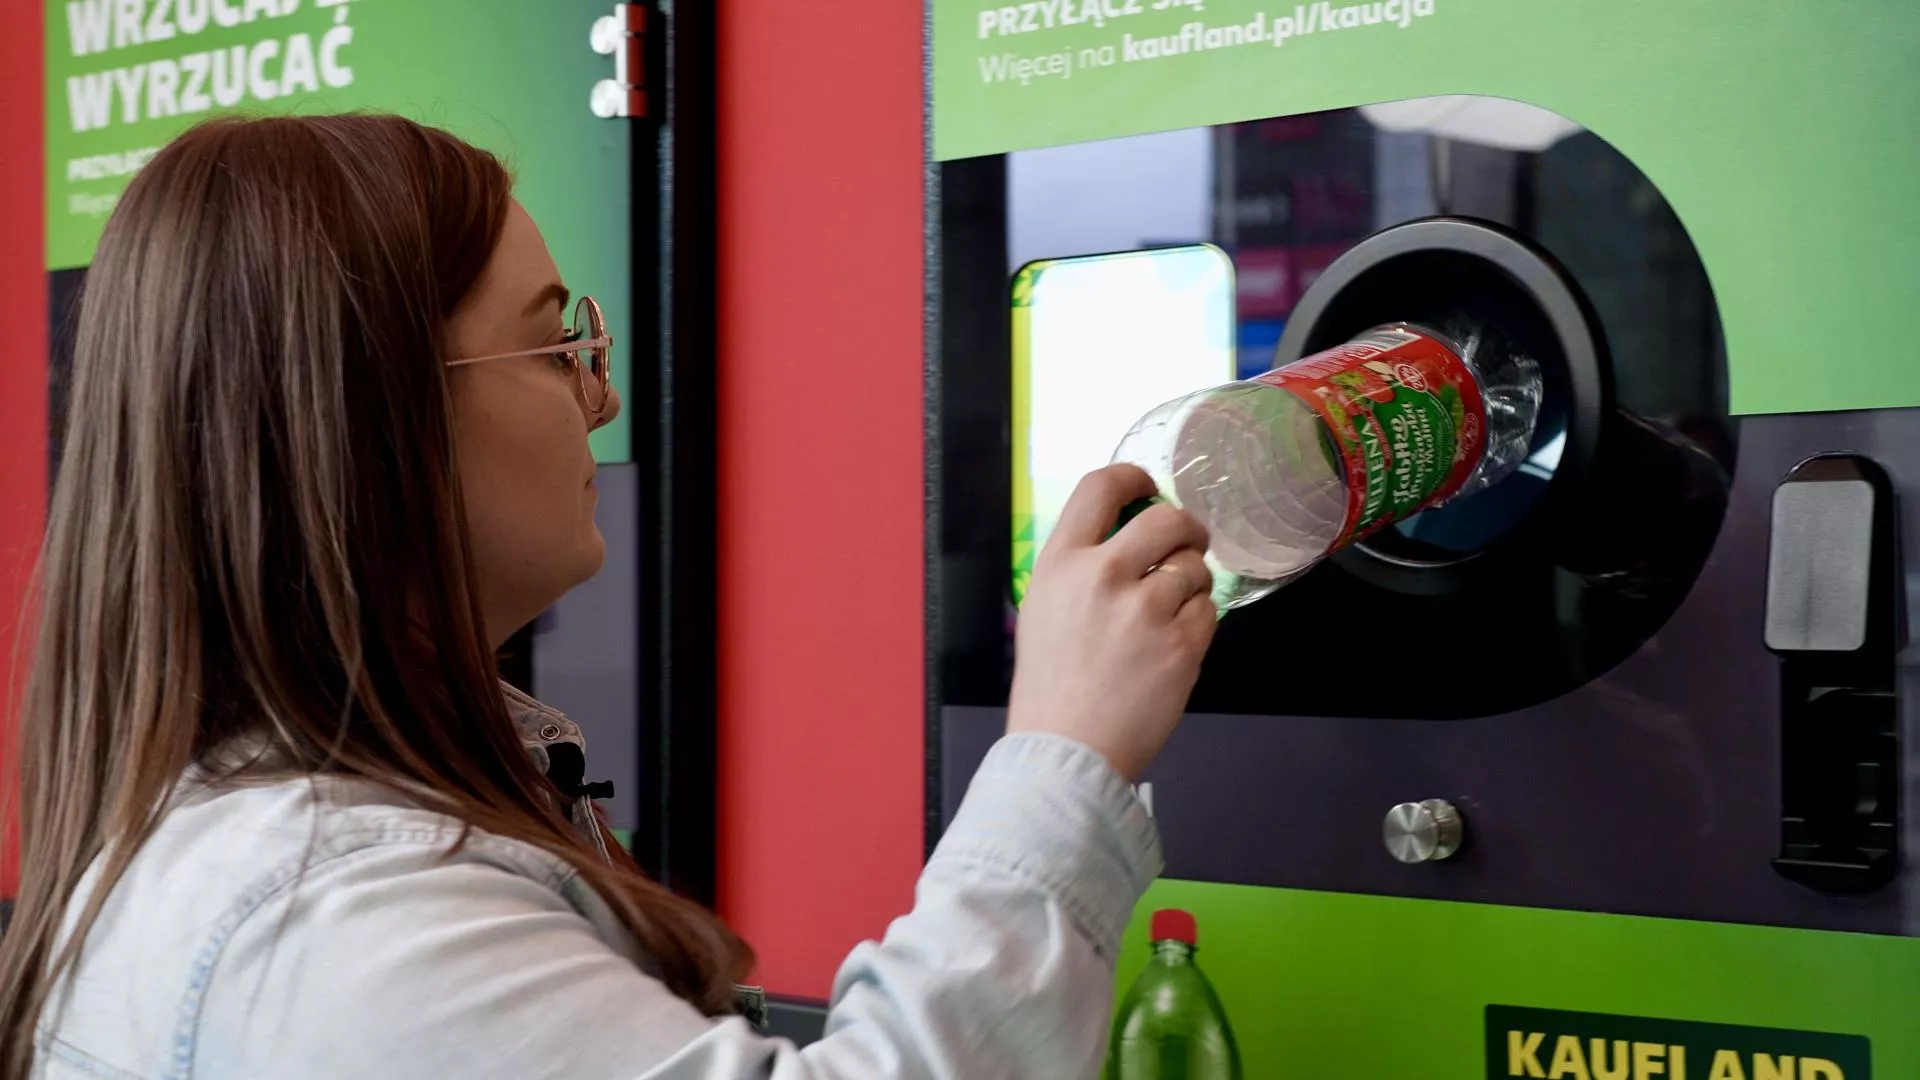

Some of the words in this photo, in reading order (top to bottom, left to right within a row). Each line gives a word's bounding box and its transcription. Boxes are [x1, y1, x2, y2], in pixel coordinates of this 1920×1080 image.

[67, 6, 354, 132] WYRZUCAĆ
[978, 46, 1072, 85] Więcej
[1079, 45, 1116, 69] na
[1122, 0, 1436, 62] kaufland.pl/kaucja
